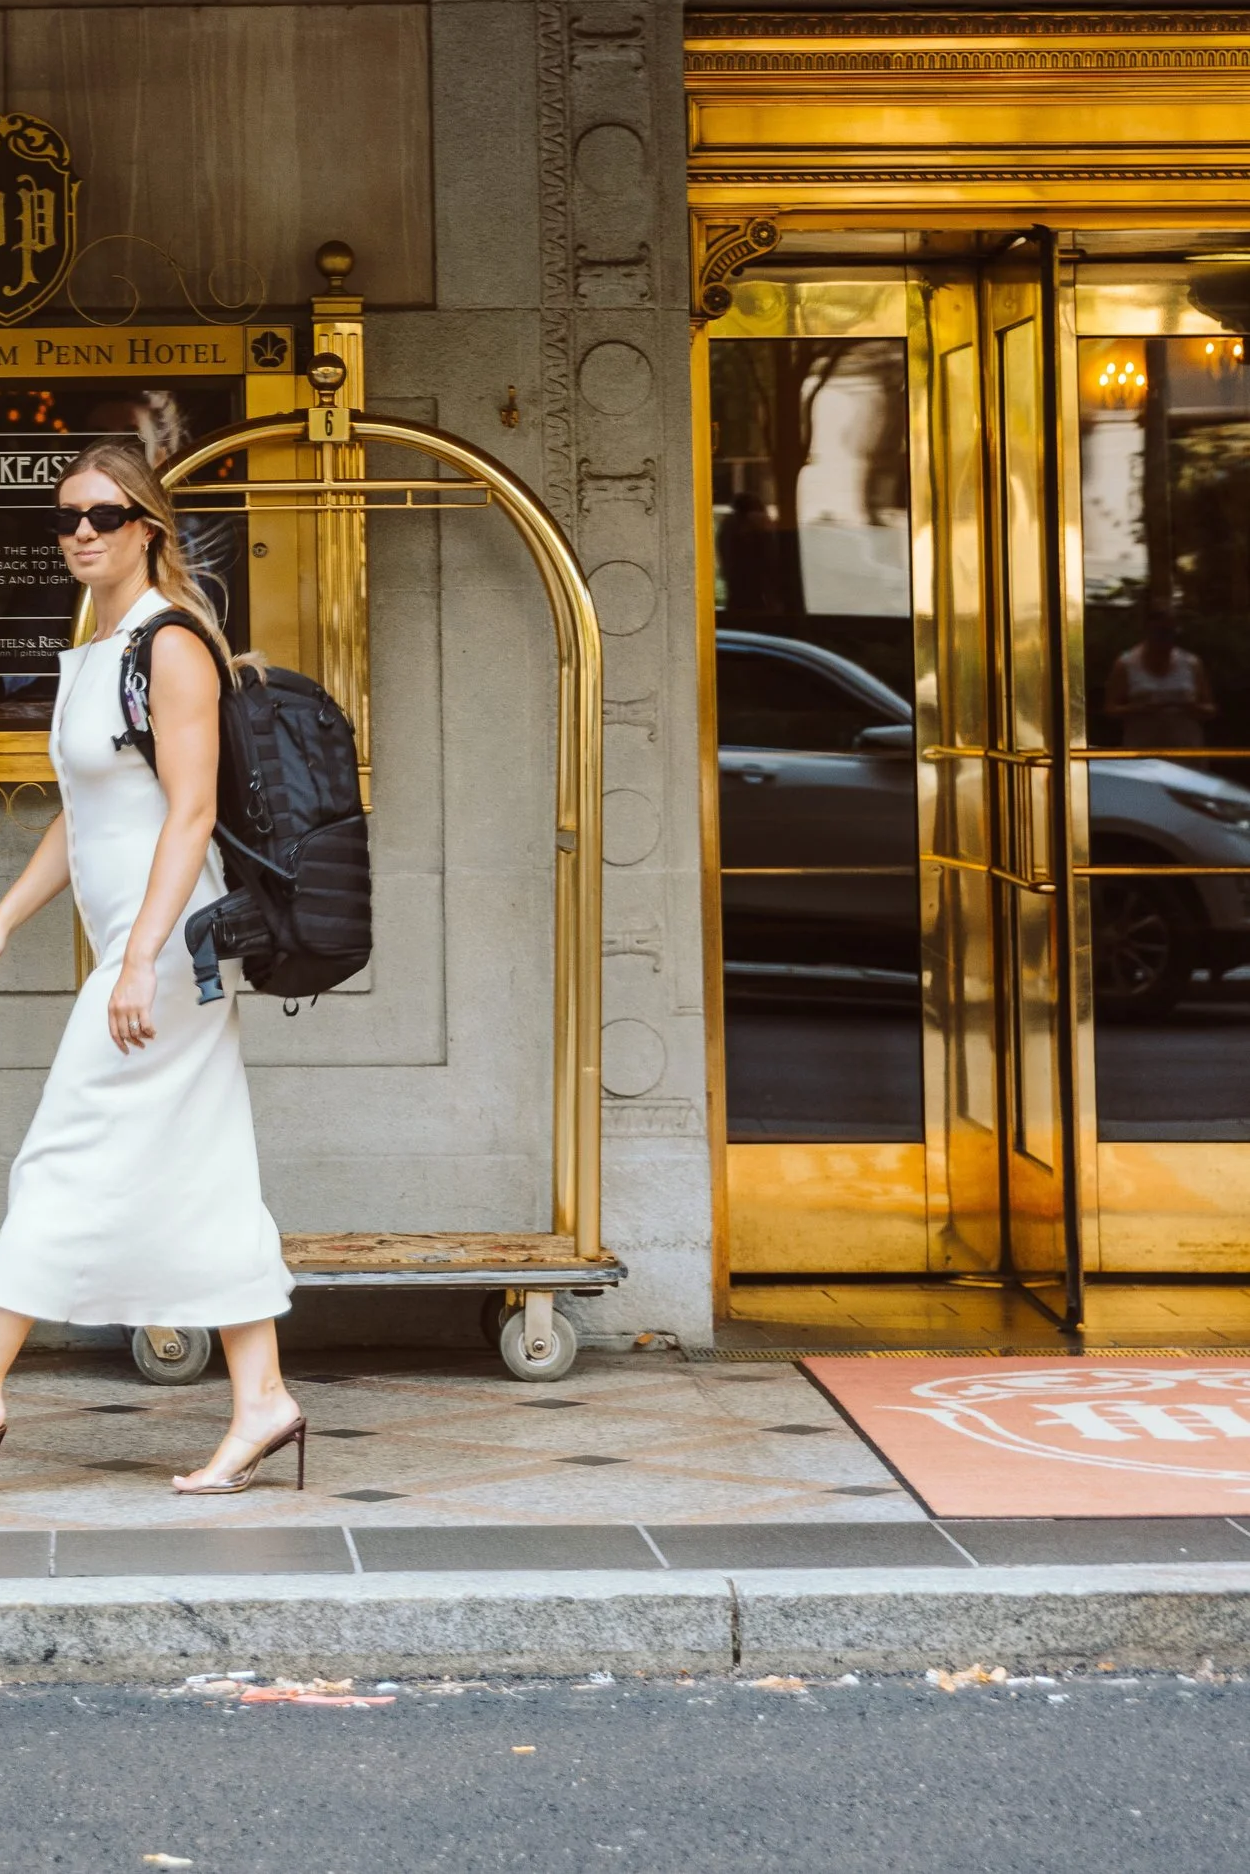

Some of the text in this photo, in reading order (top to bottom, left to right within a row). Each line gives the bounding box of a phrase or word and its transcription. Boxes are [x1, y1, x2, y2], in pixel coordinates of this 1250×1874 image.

[324, 409, 334, 437] 6
[3, 546, 28, 556] THE
[31, 546, 64, 556] HOTE
[31, 560, 47, 570] TO
[8, 575, 35, 585] AND
